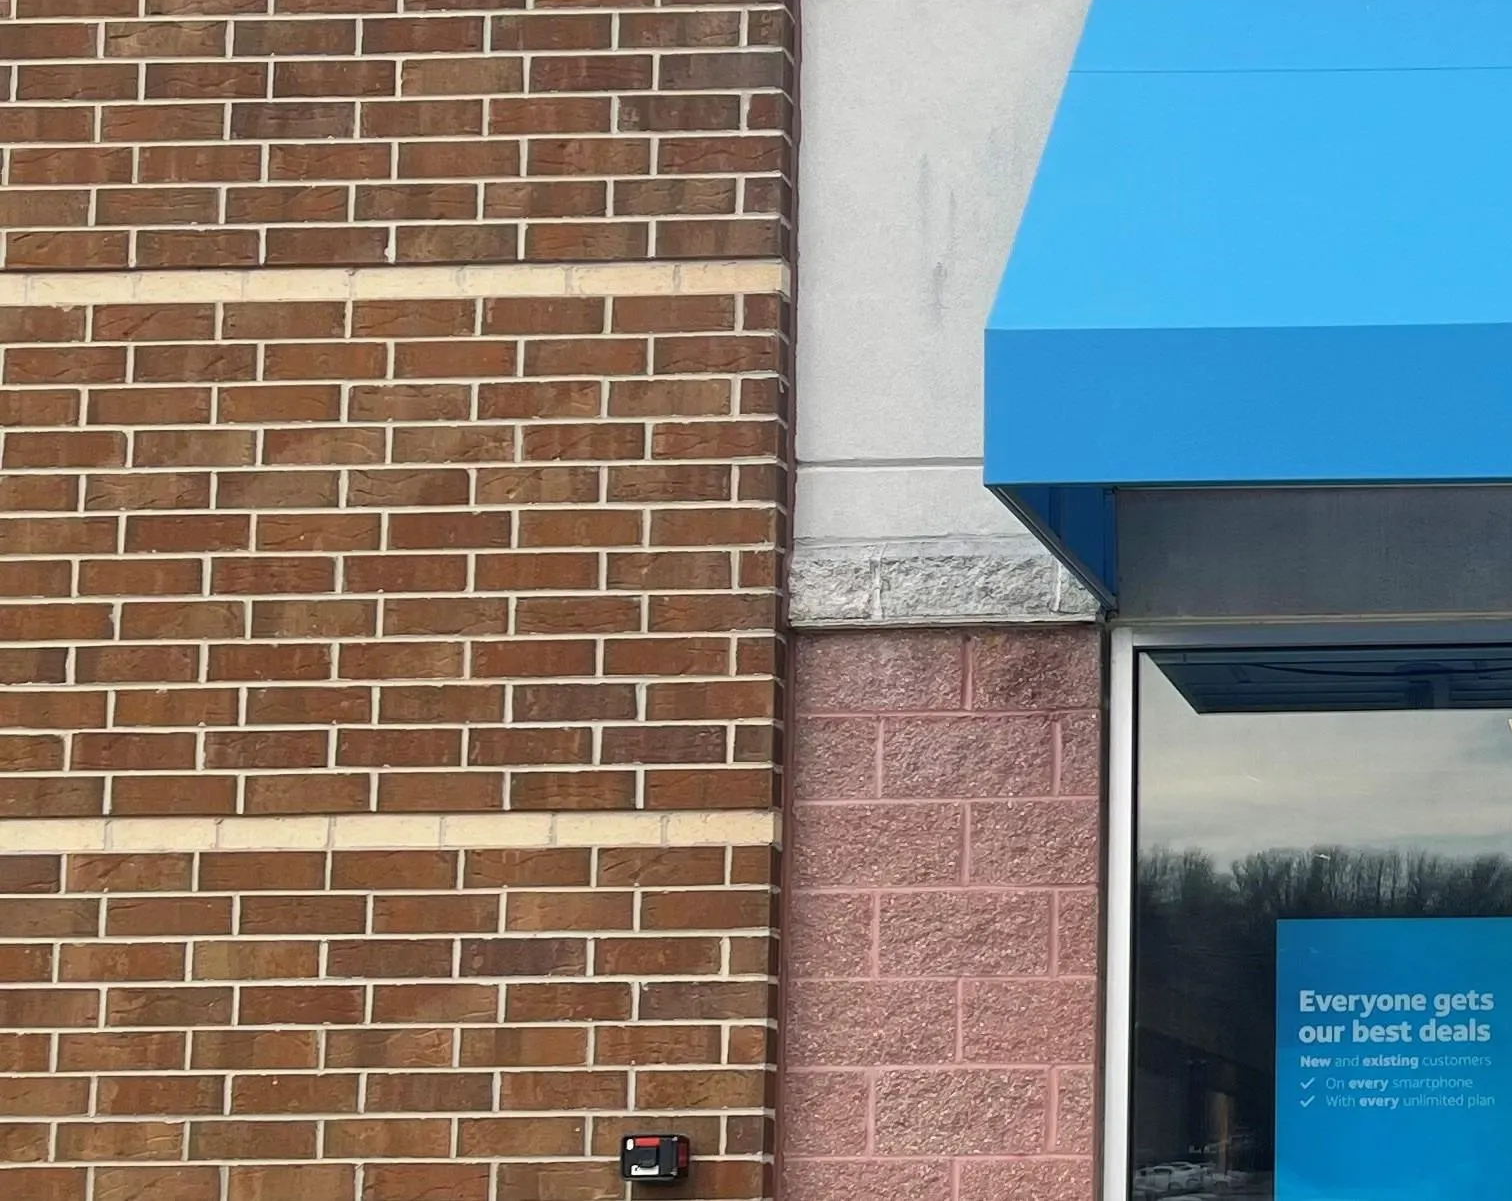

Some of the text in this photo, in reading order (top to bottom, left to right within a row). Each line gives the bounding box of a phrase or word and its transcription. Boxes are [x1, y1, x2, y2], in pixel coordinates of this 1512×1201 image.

[1300, 989, 1495, 1018] Everyone gets
[1299, 1018, 1491, 1043] our best deals
[1300, 1054, 1492, 1070] New and existing customers
[1326, 1076, 1473, 1092] On every smartphone
[1326, 1093, 1496, 1110] With every unlimited plan
